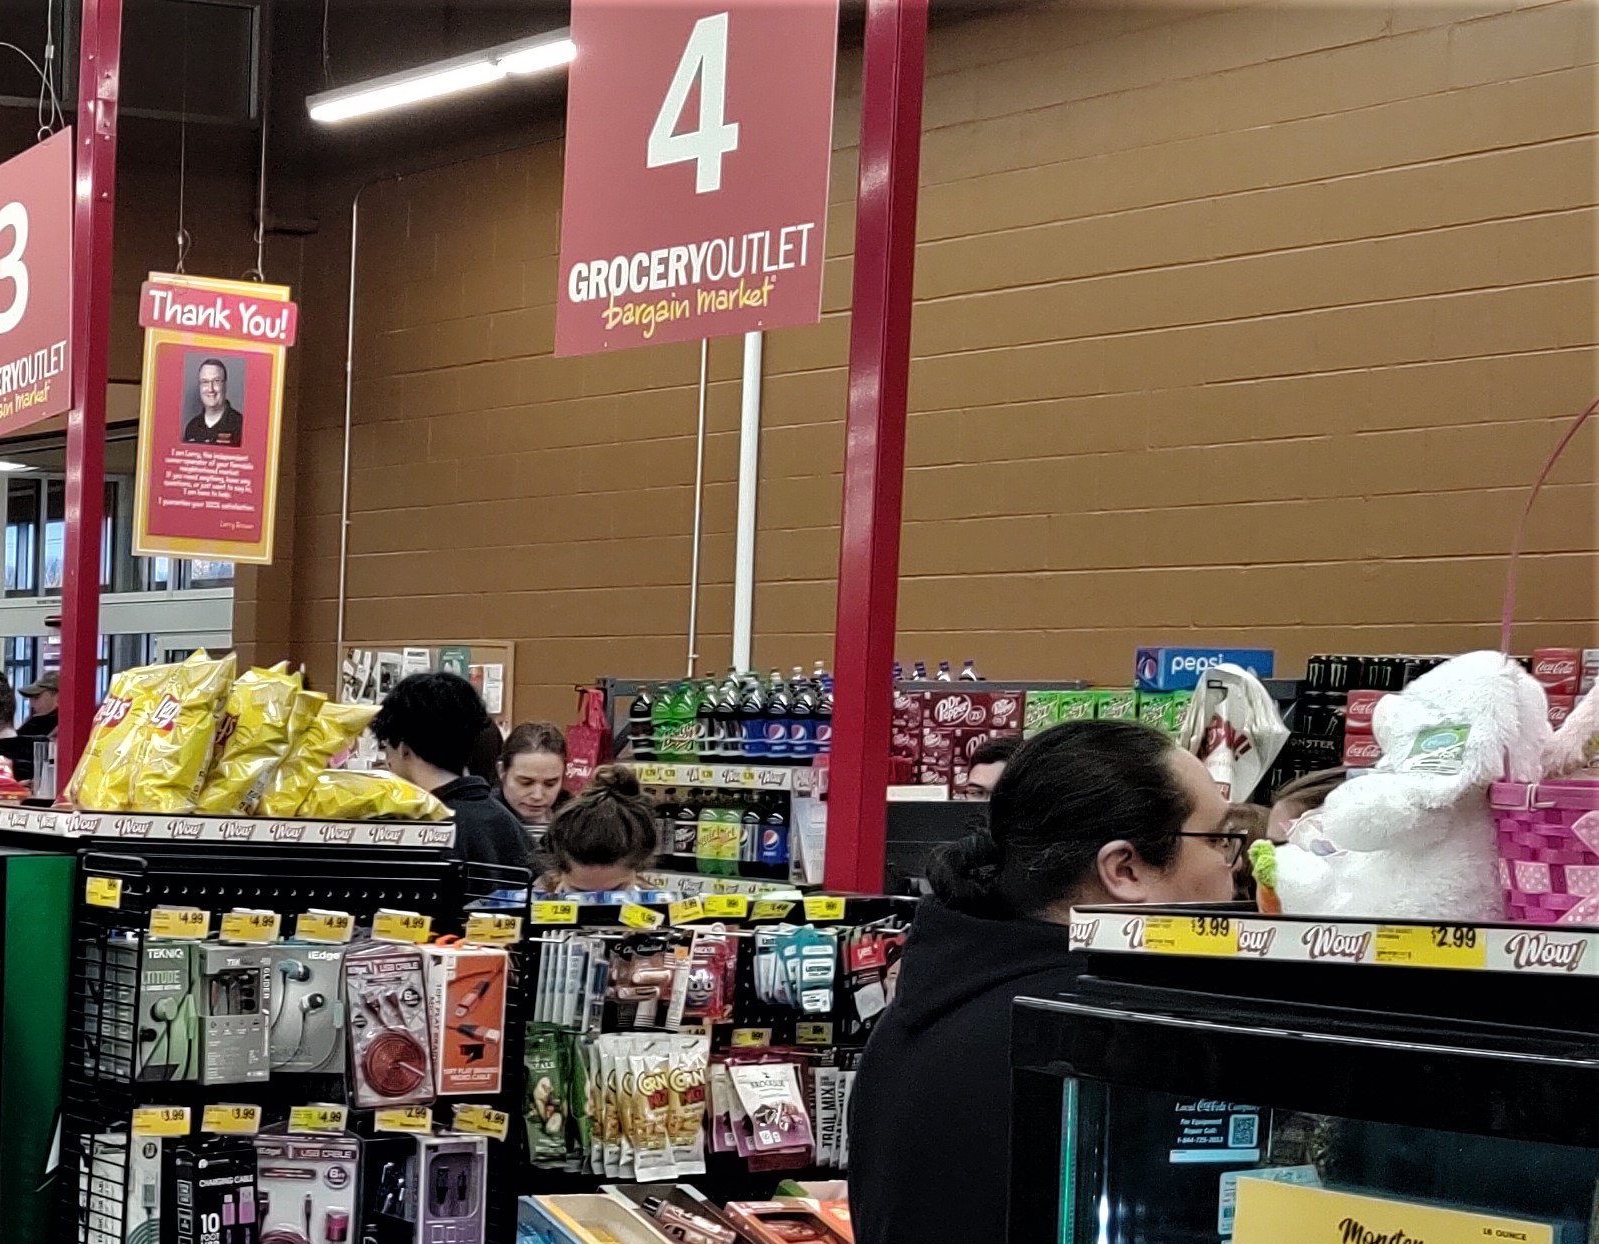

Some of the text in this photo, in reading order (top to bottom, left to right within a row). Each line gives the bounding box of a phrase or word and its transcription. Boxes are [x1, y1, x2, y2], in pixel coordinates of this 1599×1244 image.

[647, 11, 738, 193] 4
[149, 289, 288, 340] Thank You!
[602, 276, 774, 338] bargain market
[15, 384, 50, 414] market
[1171, 653, 1224, 675] pepsi
[1535, 661, 1574, 675] Coca-Cola
[934, 698, 972, 724] Pepper
[179, 912, 204, 924] $4.99
[250, 915, 274, 927] $4.99
[324, 916, 348, 928] $4.99
[400, 916, 425, 929] $4.99
[1191, 916, 1230, 939] $3.99
[1069, 918, 1099, 947] ow!
[1239, 922, 1275, 955] ow!
[1431, 926, 1476, 950] $2.99
[1302, 926, 1371, 962] Wow!
[1506, 931, 1587, 971] Wow!
[308, 951, 340, 961] iEdge
[638, 1070, 667, 1095] CORN
[670, 1069, 704, 1094] CORN
[161, 1109, 184, 1121] $3.99
[232, 1108, 255, 1120] $3.99
[318, 1111, 341, 1123] $4.99
[822, 1085, 836, 1147] TRAIL MIX
[300, 1149, 351, 1159] USB CABLE
[199, 1174, 254, 1187] CHARGING CABLE
[201, 1213, 220, 1233] 10
[201, 1233, 220, 1241] FOOT
[1495, 1229, 1528, 1241] OUNCE
